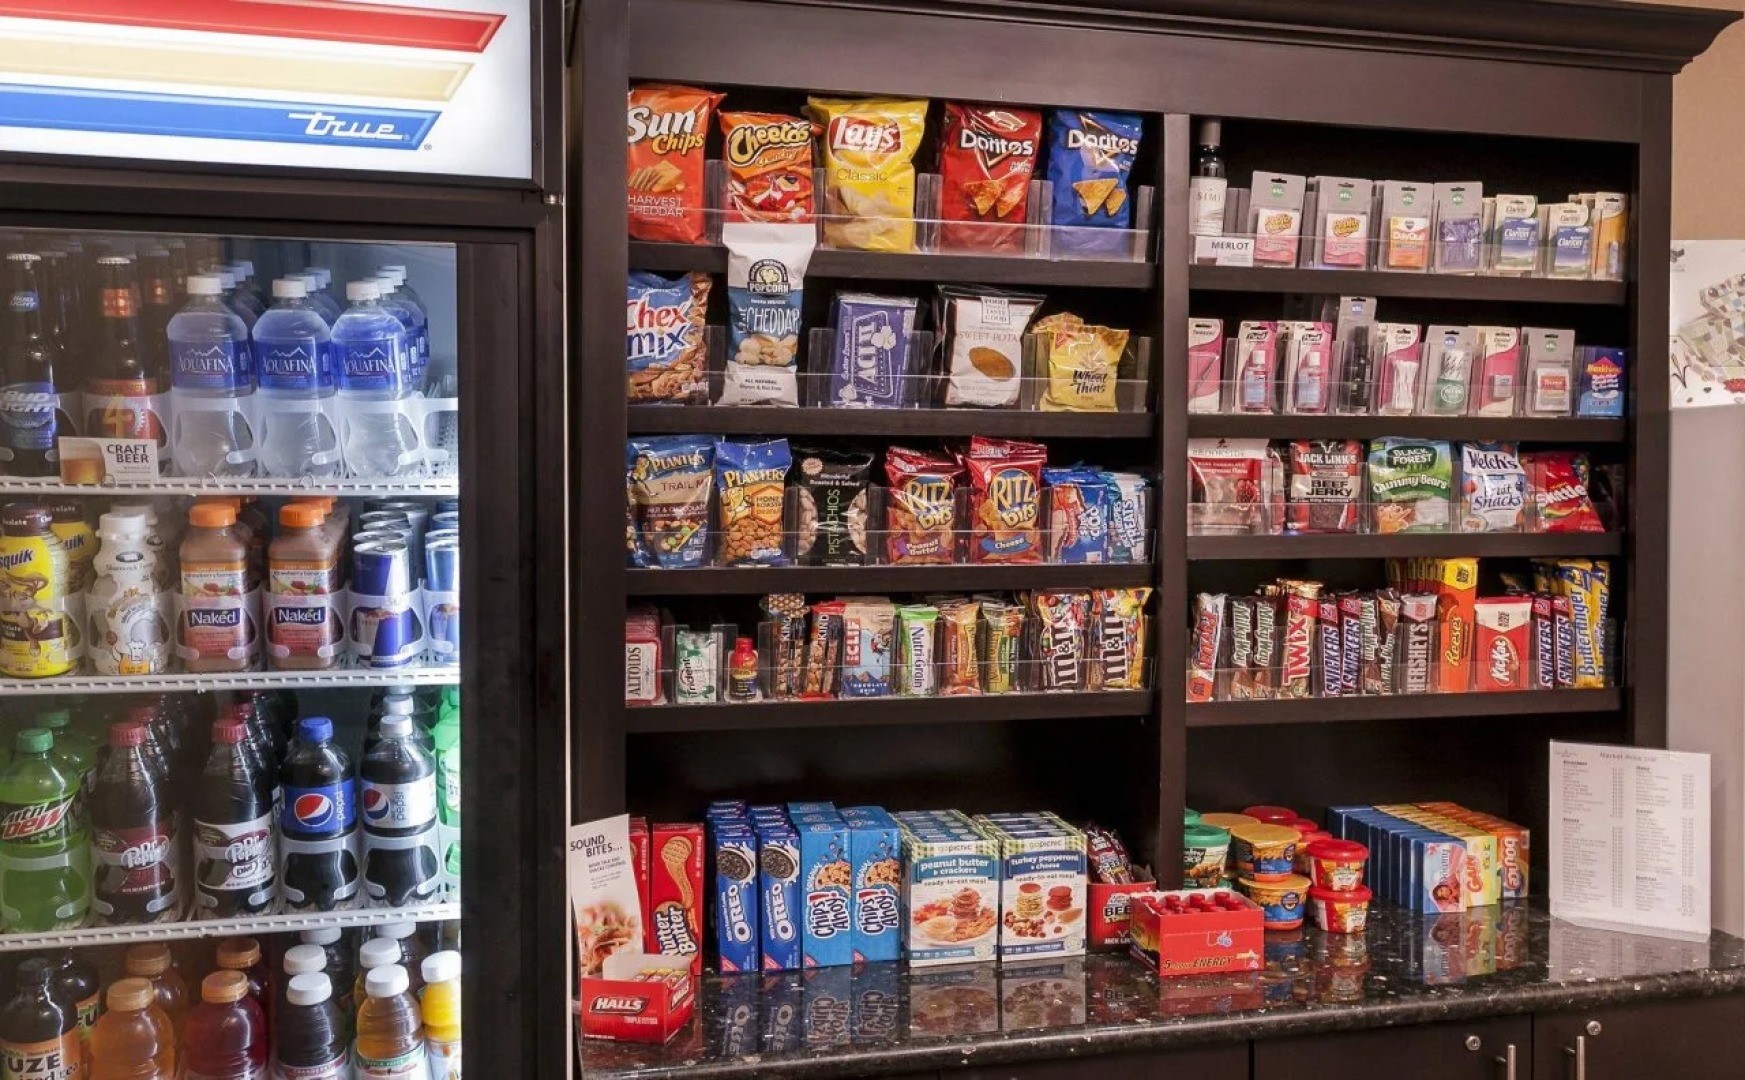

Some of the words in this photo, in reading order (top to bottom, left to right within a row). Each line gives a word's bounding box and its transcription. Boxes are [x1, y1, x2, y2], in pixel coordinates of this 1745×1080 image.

[288, 111, 402, 140] true
[627, 107, 695, 142] Sun
[728, 121, 812, 166] Cheetos
[833, 117, 901, 152] Lay's
[960, 129, 1033, 155] Doritos
[1068, 129, 1138, 155] Doritos
[652, 133, 704, 155] Chips
[837, 168, 887, 182] Classic
[628, 194, 682, 206] HARVEST
[1197, 191, 1222, 202] SIMI
[628, 205, 684, 217] CHEDDAR
[1211, 241, 1249, 251] MERLOT
[749, 283, 789, 293] POPCORN
[627, 300, 688, 331] Chex
[747, 307, 800, 335] CHEDDAR
[958, 331, 989, 341] SWEET
[178, 359, 233, 373] AQUAFINA
[263, 359, 316, 373] AQUAFINA
[344, 359, 396, 373] AQUAFINA
[1072, 370, 1107, 383] Wheat
[1070, 381, 1106, 394] Thins
[107, 444, 147, 454] CRAFT
[116, 453, 149, 463] BEER
[651, 454, 705, 471] PLANTERS
[1299, 454, 1323, 464] JACK
[1325, 454, 1356, 464] LINK'S
[1393, 454, 1432, 466] FOREST
[1468, 450, 1518, 470] Welch's
[660, 481, 695, 491] TRAIL
[723, 469, 785, 487] PLANTERS
[1311, 480, 1348, 488] BEEF
[1373, 476, 1419, 493] Gummy
[904, 481, 949, 513] RITZ
[991, 478, 1036, 511] RITZ
[1305, 488, 1352, 497] JERKY
[1484, 484, 1513, 496] Fruit
[1473, 495, 1521, 510] Snacks
[828, 489, 840, 555] PISTACHIOS
[1001, 503, 1037, 528] bits
[1122, 499, 1145, 547] TREATS
[906, 540, 939, 551] Peanut
[908, 547, 939, 557] Butter
[994, 537, 1025, 549] Cheese
[191, 610, 237, 624] Naked
[278, 607, 323, 622] Naked
[780, 616, 792, 641] KIND
[818, 613, 830, 641] KIND
[1571, 588, 1596, 677] Butterfinger
[846, 620, 860, 655] CLIF
[1282, 617, 1311, 687] TWIX
[1325, 626, 1342, 695] SNICKERS
[1343, 618, 1362, 690] SNICKERS
[1407, 623, 1428, 692] HERSHEY'S
[1540, 621, 1553, 688] SNICKERS
[1558, 617, 1573, 686] SNICKERS
[627, 647, 641, 696] ALTOIDS
[680, 658, 694, 697] Trident
[1600, 752, 1623, 760] Market
[336, 790, 345, 822] pepsi
[395, 791, 405, 822] pepsi
[570, 834, 606, 852] SOUND
[920, 858, 956, 871] peanut
[958, 858, 989, 868] butter
[1010, 856, 1037, 867] turkey
[1038, 854, 1079, 864] pepperoni
[1504, 837, 1521, 891] Bounce
[940, 867, 977, 875] crackers
[1015, 874, 1058, 883] ready-to-eat
[923, 878, 968, 887] ready-to-eat
[728, 884, 751, 942] OREO
[772, 883, 794, 940] OREO
[812, 901, 835, 938] Chips
[861, 899, 885, 934] Chips
[670, 906, 696, 954] Butter
[1193, 957, 1233, 968] ENERGY
[596, 998, 643, 1010] HALLS
[7, 1051, 61, 1073] UZE
